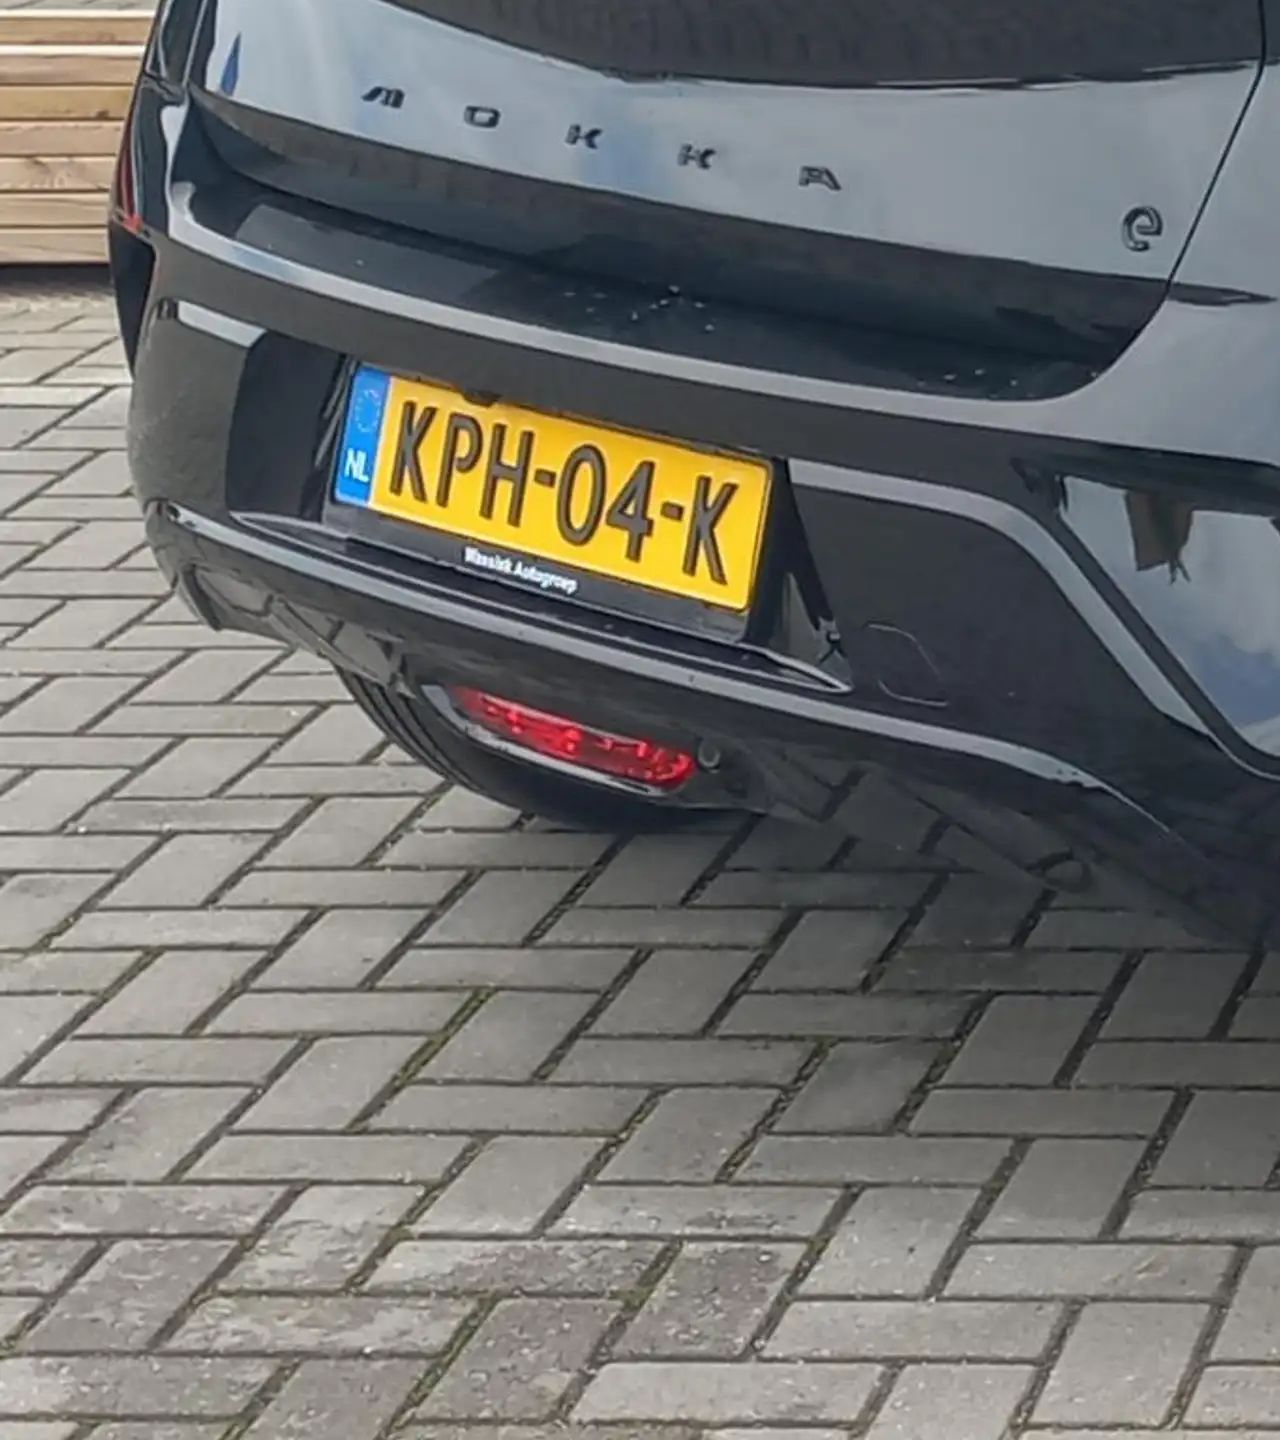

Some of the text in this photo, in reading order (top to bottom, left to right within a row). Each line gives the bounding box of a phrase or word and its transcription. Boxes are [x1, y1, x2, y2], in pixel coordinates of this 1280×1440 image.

[361, 85, 842, 191] MOKKA
[343, 448, 370, 483] NL
[389, 400, 739, 585] KPH-04-K
